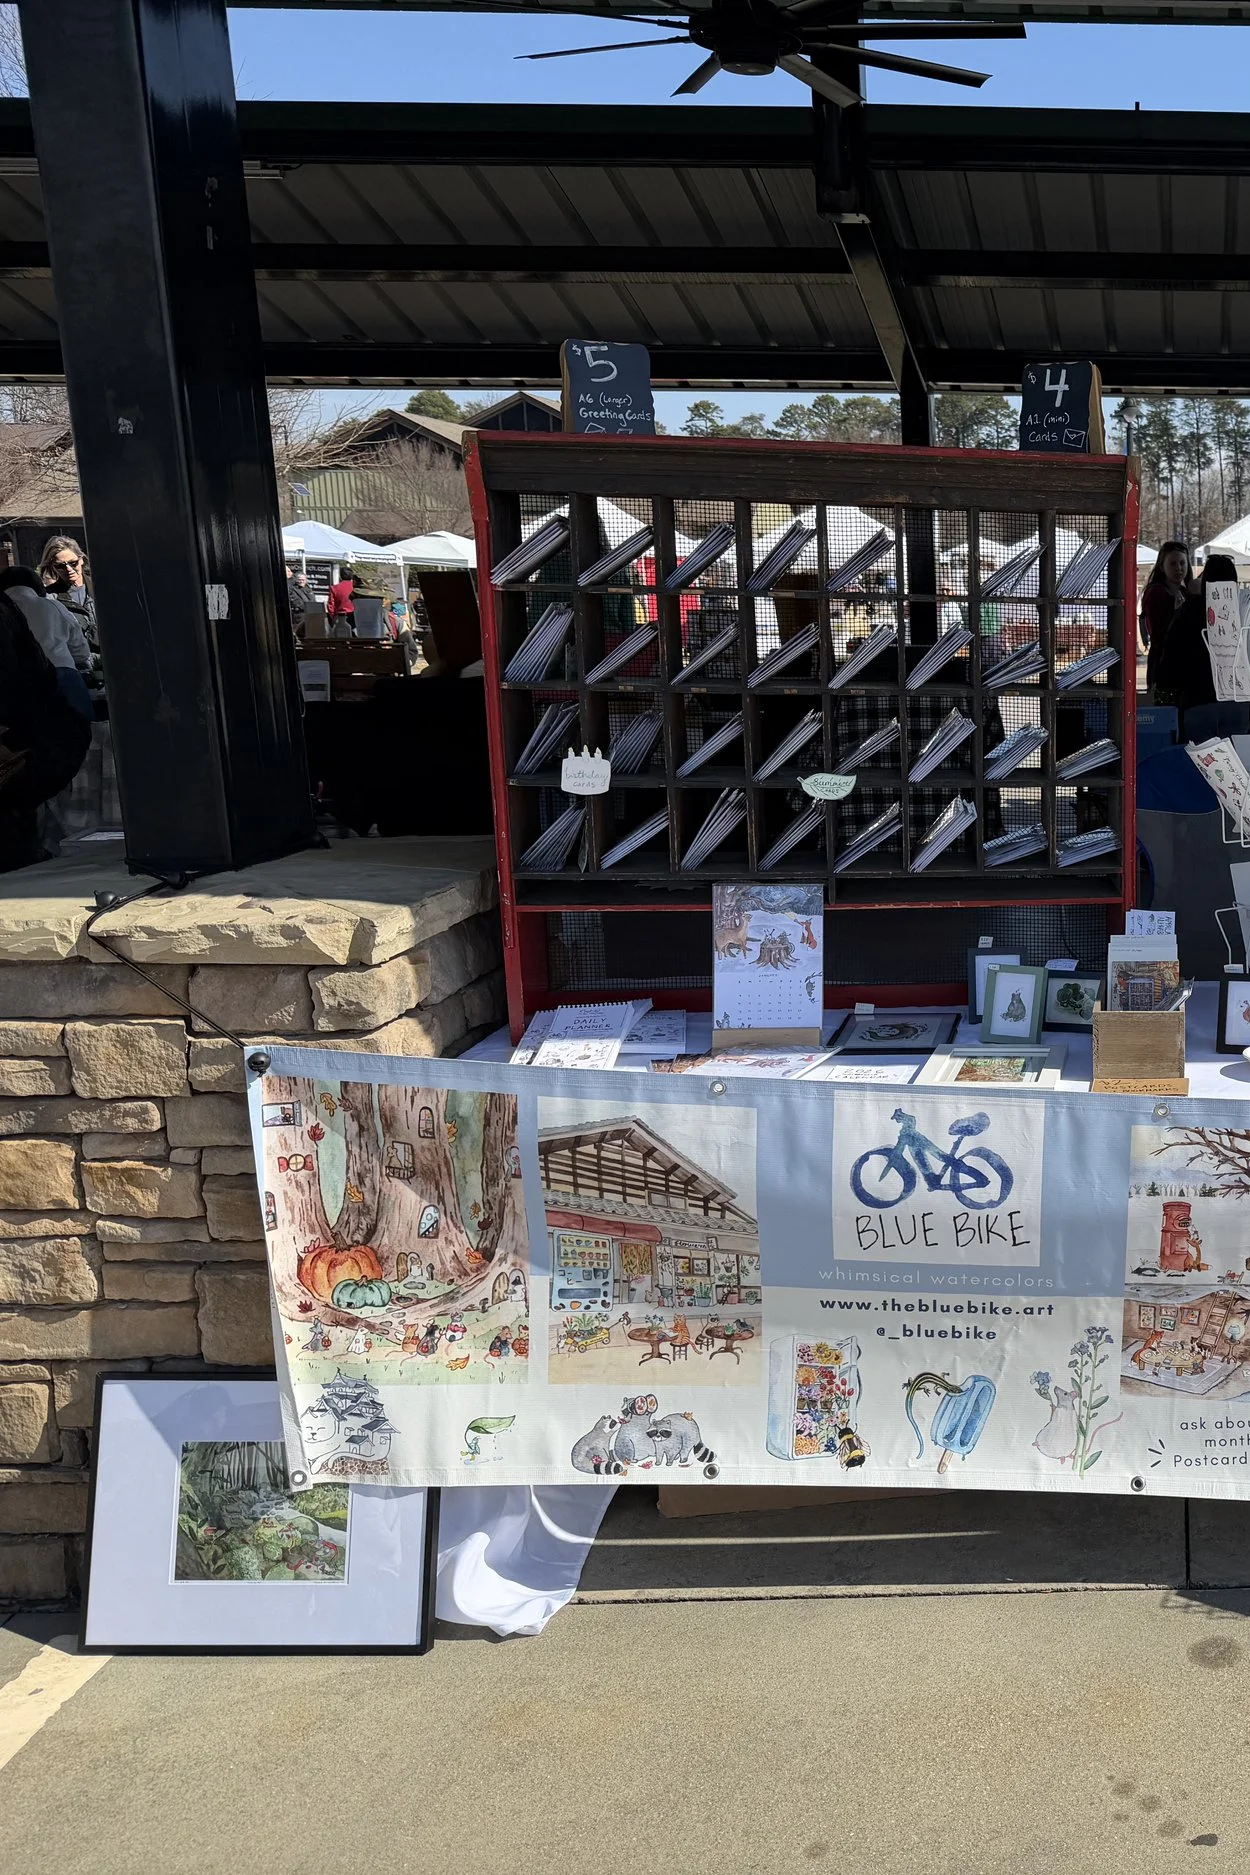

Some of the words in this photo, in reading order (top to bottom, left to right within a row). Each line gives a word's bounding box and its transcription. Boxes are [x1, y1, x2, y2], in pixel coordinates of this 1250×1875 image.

[579, 393, 594, 403] A6
[579, 407, 627, 427] Greeting
[625, 410, 651, 420] Cards
[1043, 412, 1070, 428] (mini)
[1028, 431, 1058, 442] Cards
[565, 767, 608, 787] birthday
[573, 781, 596, 789] cards
[813, 777, 852, 788] Summer
[564, 1023, 611, 1031] PLANNER
[573, 1017, 608, 1025] DAILY
[856, 1212, 939, 1250] BLUE
[953, 1211, 1031, 1247] BIKE
[818, 1267, 920, 1284] whimsical
[930, 1272, 1054, 1288] watercolors
[820, 1299, 1055, 1316] www.thebluebike.art
[876, 1324, 997, 1340] @_bluebike
[1180, 1417, 1206, 1430] ask
[1174, 1451, 1248, 1467] Postcard
